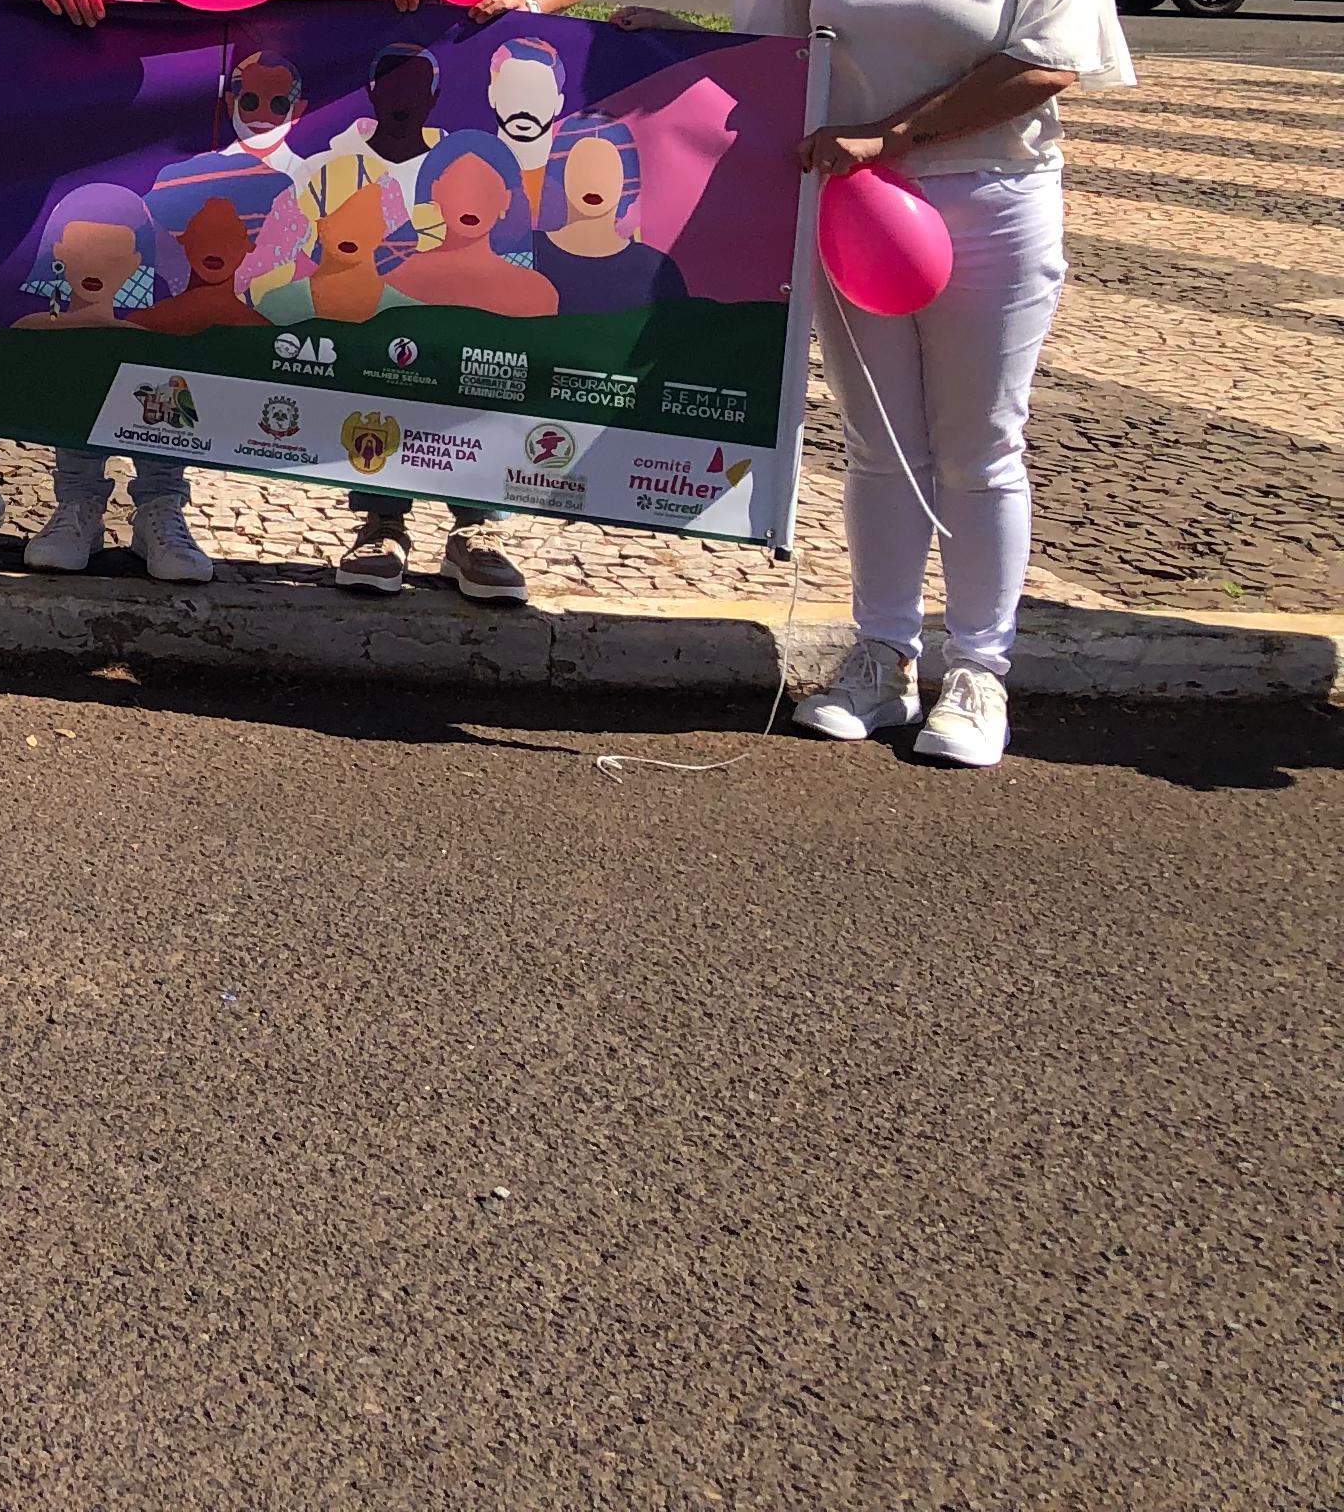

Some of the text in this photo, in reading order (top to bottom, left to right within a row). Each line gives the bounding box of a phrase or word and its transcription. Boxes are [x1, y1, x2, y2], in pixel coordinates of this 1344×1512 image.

[273, 333, 337, 364] OAB
[462, 347, 528, 368] PARANÁ
[272, 359, 335, 377] PARANÁ
[461, 361, 512, 379] UNIDO
[551, 374, 636, 396] SEGURANÇA
[550, 387, 636, 410] PR.GOV.BR
[661, 401, 745, 423] PR.GOV.BR
[114, 427, 169, 445] Jandaia
[171, 435, 189, 448] do
[191, 437, 212, 451] Sul
[404, 429, 482, 451] PATRULHA
[234, 444, 318, 465] Jandaia do Sul
[400, 454, 454, 472] PENHA
[402, 442, 477, 463] MARIA DA
[634, 457, 691, 474] comitê
[505, 468, 585, 492] Mulheres
[629, 474, 723, 500] mulher
[504, 492, 545, 505] Jandaia
[548, 497, 562, 508] do
[655, 498, 703, 515] Sicredi
